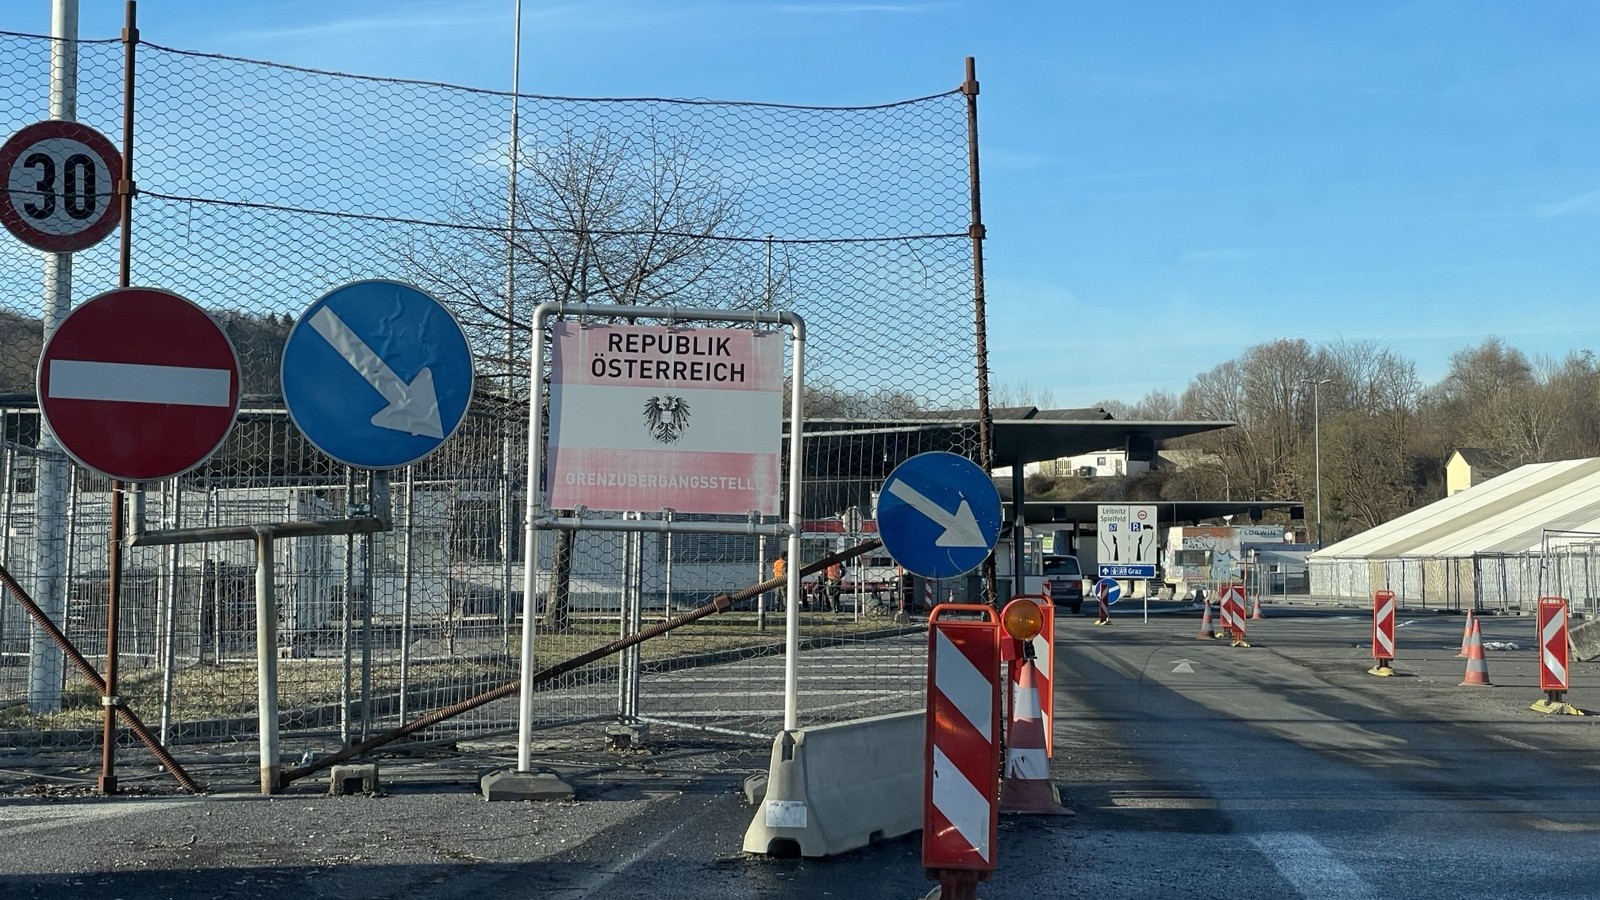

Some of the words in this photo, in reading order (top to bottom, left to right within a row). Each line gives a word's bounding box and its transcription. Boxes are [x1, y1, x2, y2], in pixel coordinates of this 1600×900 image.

[23, 153, 96, 220] 30
[608, 332, 732, 357] REPUBLIK
[591, 352, 746, 383] ÖSTERREICH
[1100, 515, 1127, 523] Spielfeld
[1102, 507, 1126, 515] Leibnitz
